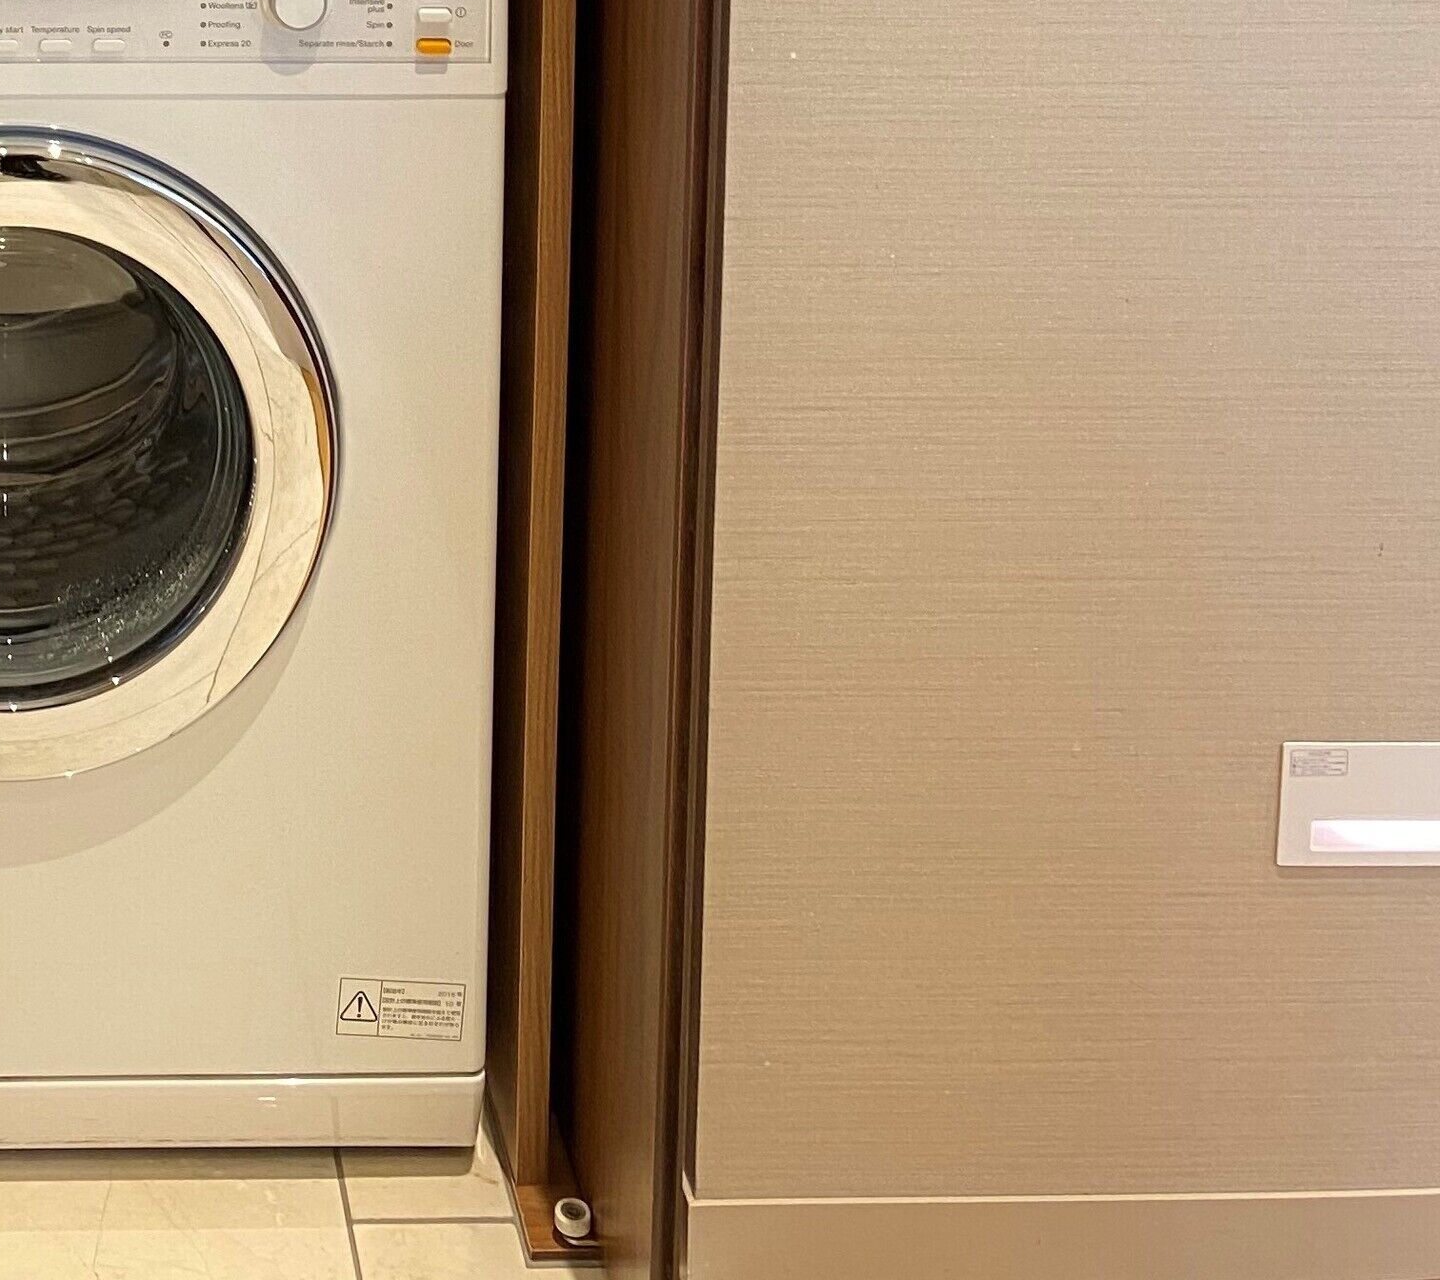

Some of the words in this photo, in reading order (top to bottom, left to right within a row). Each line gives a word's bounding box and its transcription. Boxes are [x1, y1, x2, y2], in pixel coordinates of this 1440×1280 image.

[5, 25, 24, 34] start
[86, 25, 106, 35] Spin
[454, 40, 475, 49] Door
